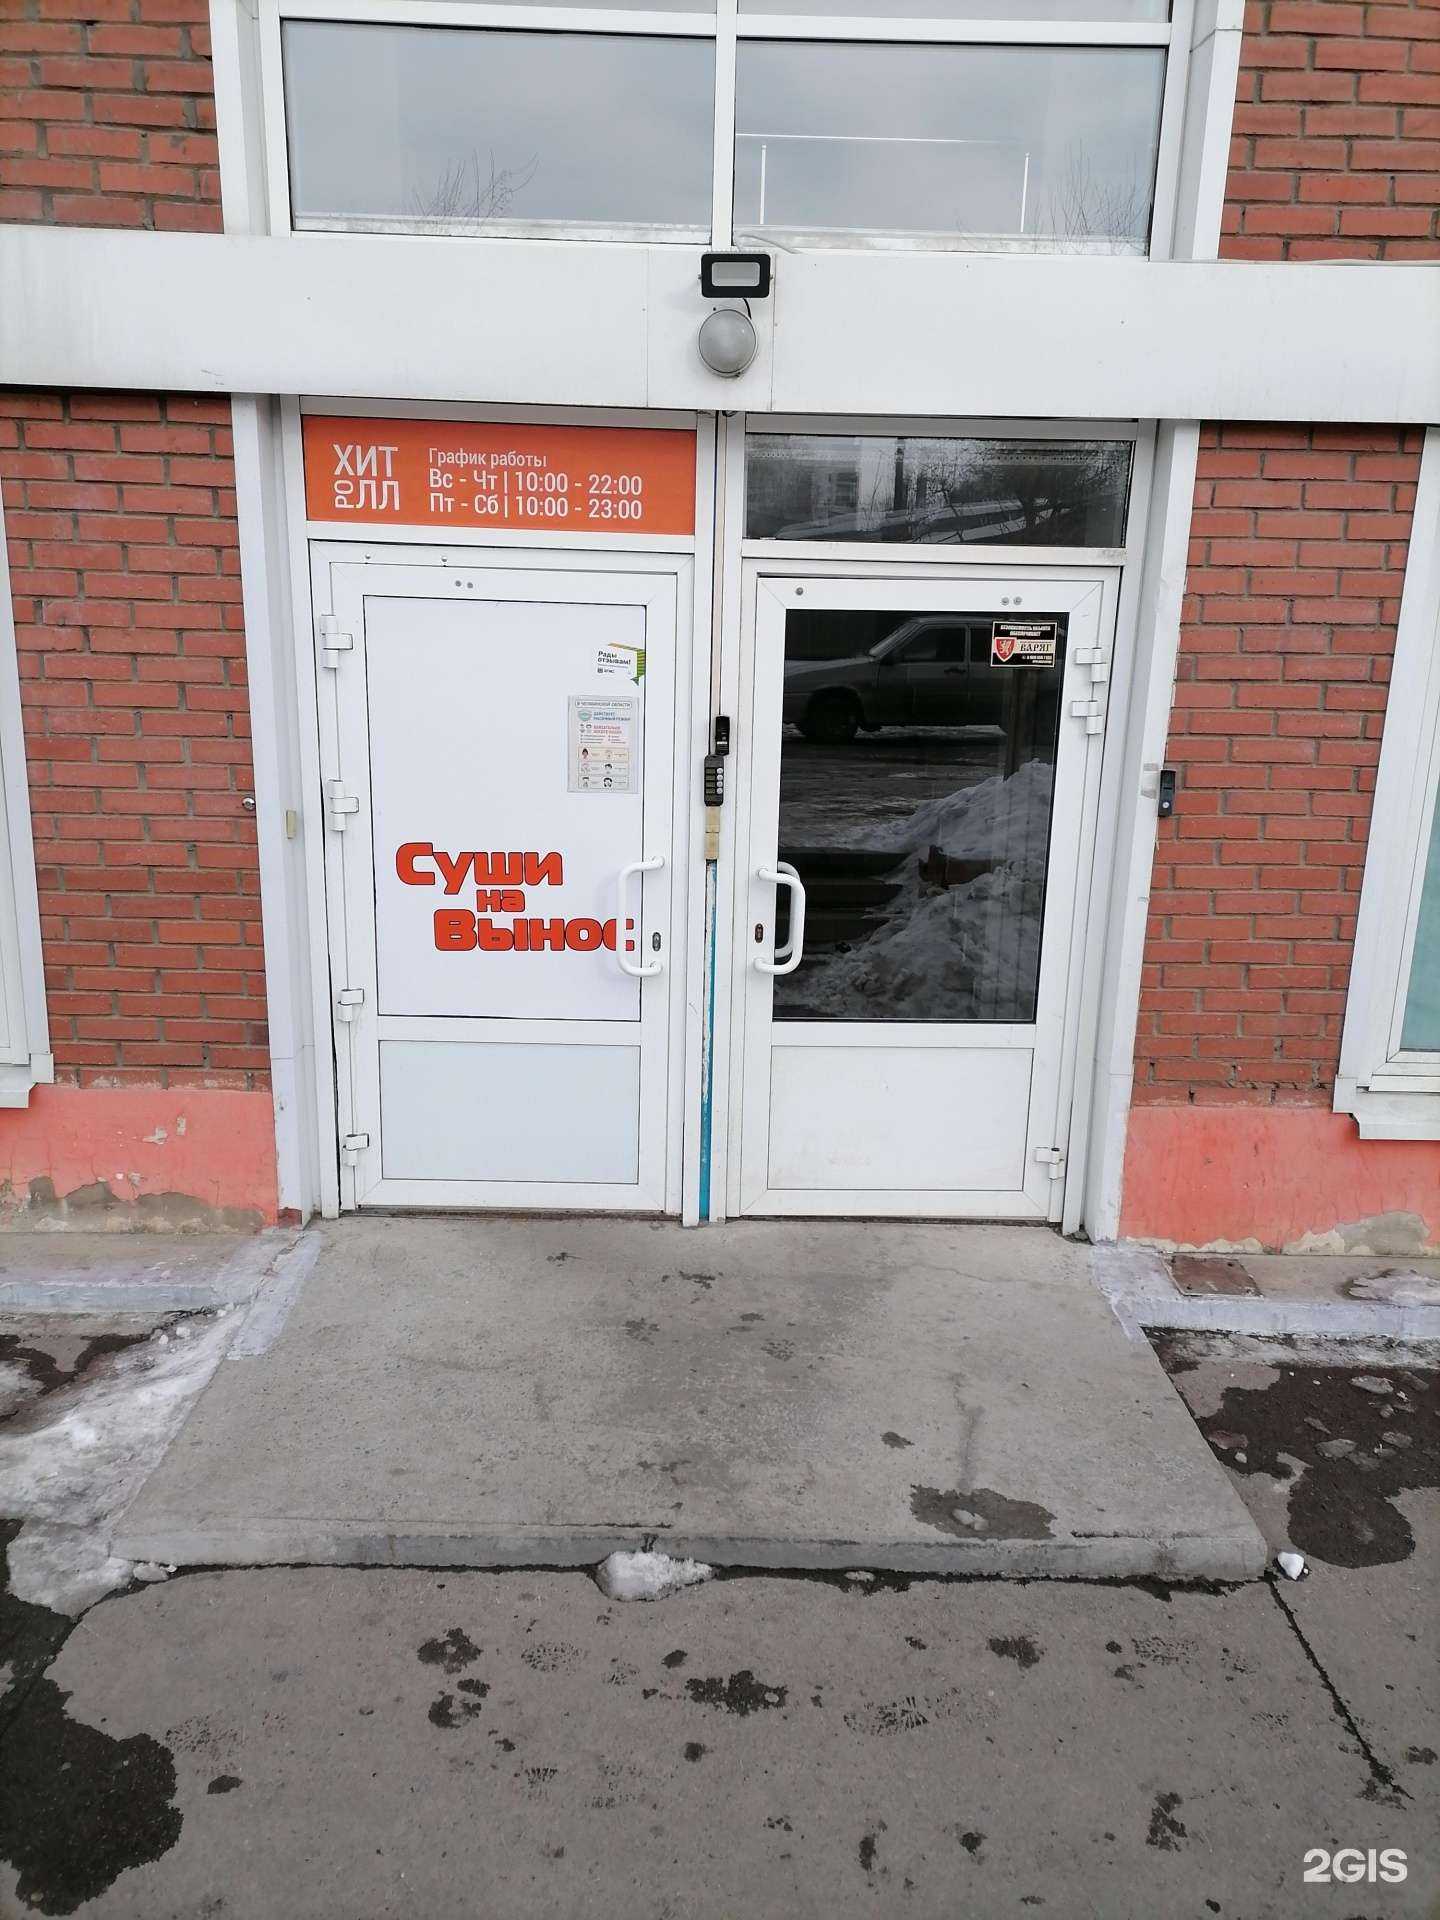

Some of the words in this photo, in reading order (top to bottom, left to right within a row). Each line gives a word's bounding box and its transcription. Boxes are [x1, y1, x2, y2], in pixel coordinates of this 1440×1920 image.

[333, 444, 398, 477] ХИТ
[429, 447, 486, 468] График
[491, 450, 547, 469] работы
[429, 468, 453, 488] Вс
[473, 469, 498, 490] Чт
[515, 471, 569, 493] 10:00
[588, 474, 642, 495] 22:00
[430, 492, 455, 512] Пт
[474, 494, 499, 514] Сб
[515, 495, 569, 517] 10:00
[588, 498, 642, 519] 23:00
[598, 650, 618, 659] Рады
[396, 842, 563, 895] Суши
[476, 889, 525, 912] на
